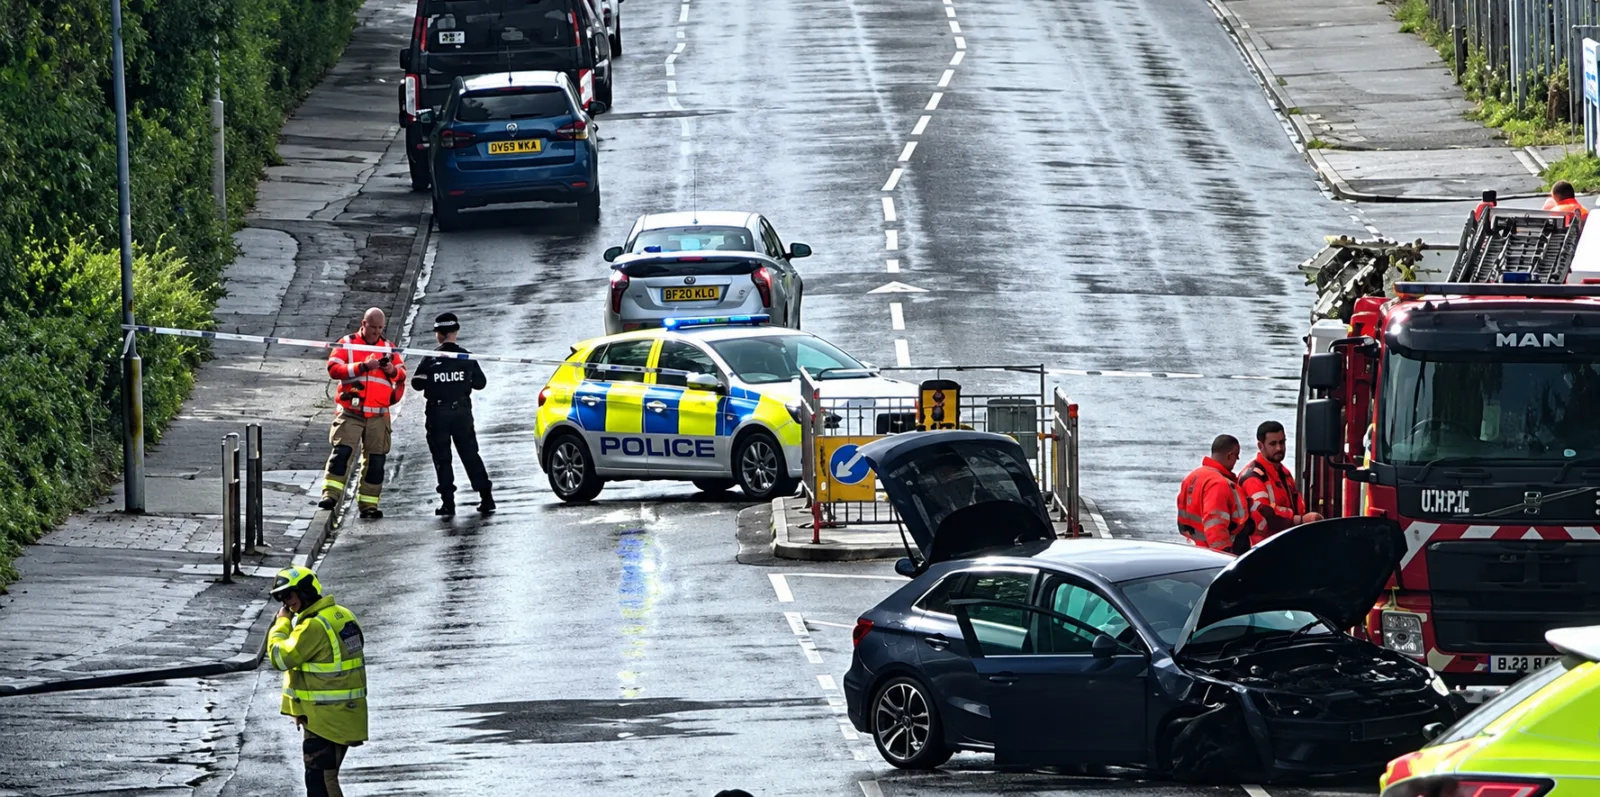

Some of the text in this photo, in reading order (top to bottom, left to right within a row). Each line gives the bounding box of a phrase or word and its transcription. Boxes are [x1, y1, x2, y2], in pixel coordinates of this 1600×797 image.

[517, 140, 537, 150] WKA
[665, 288, 692, 300] BF20
[1496, 333, 1565, 347] MAN
[433, 371, 465, 383] POLICE
[600, 436, 715, 458] POLICE
